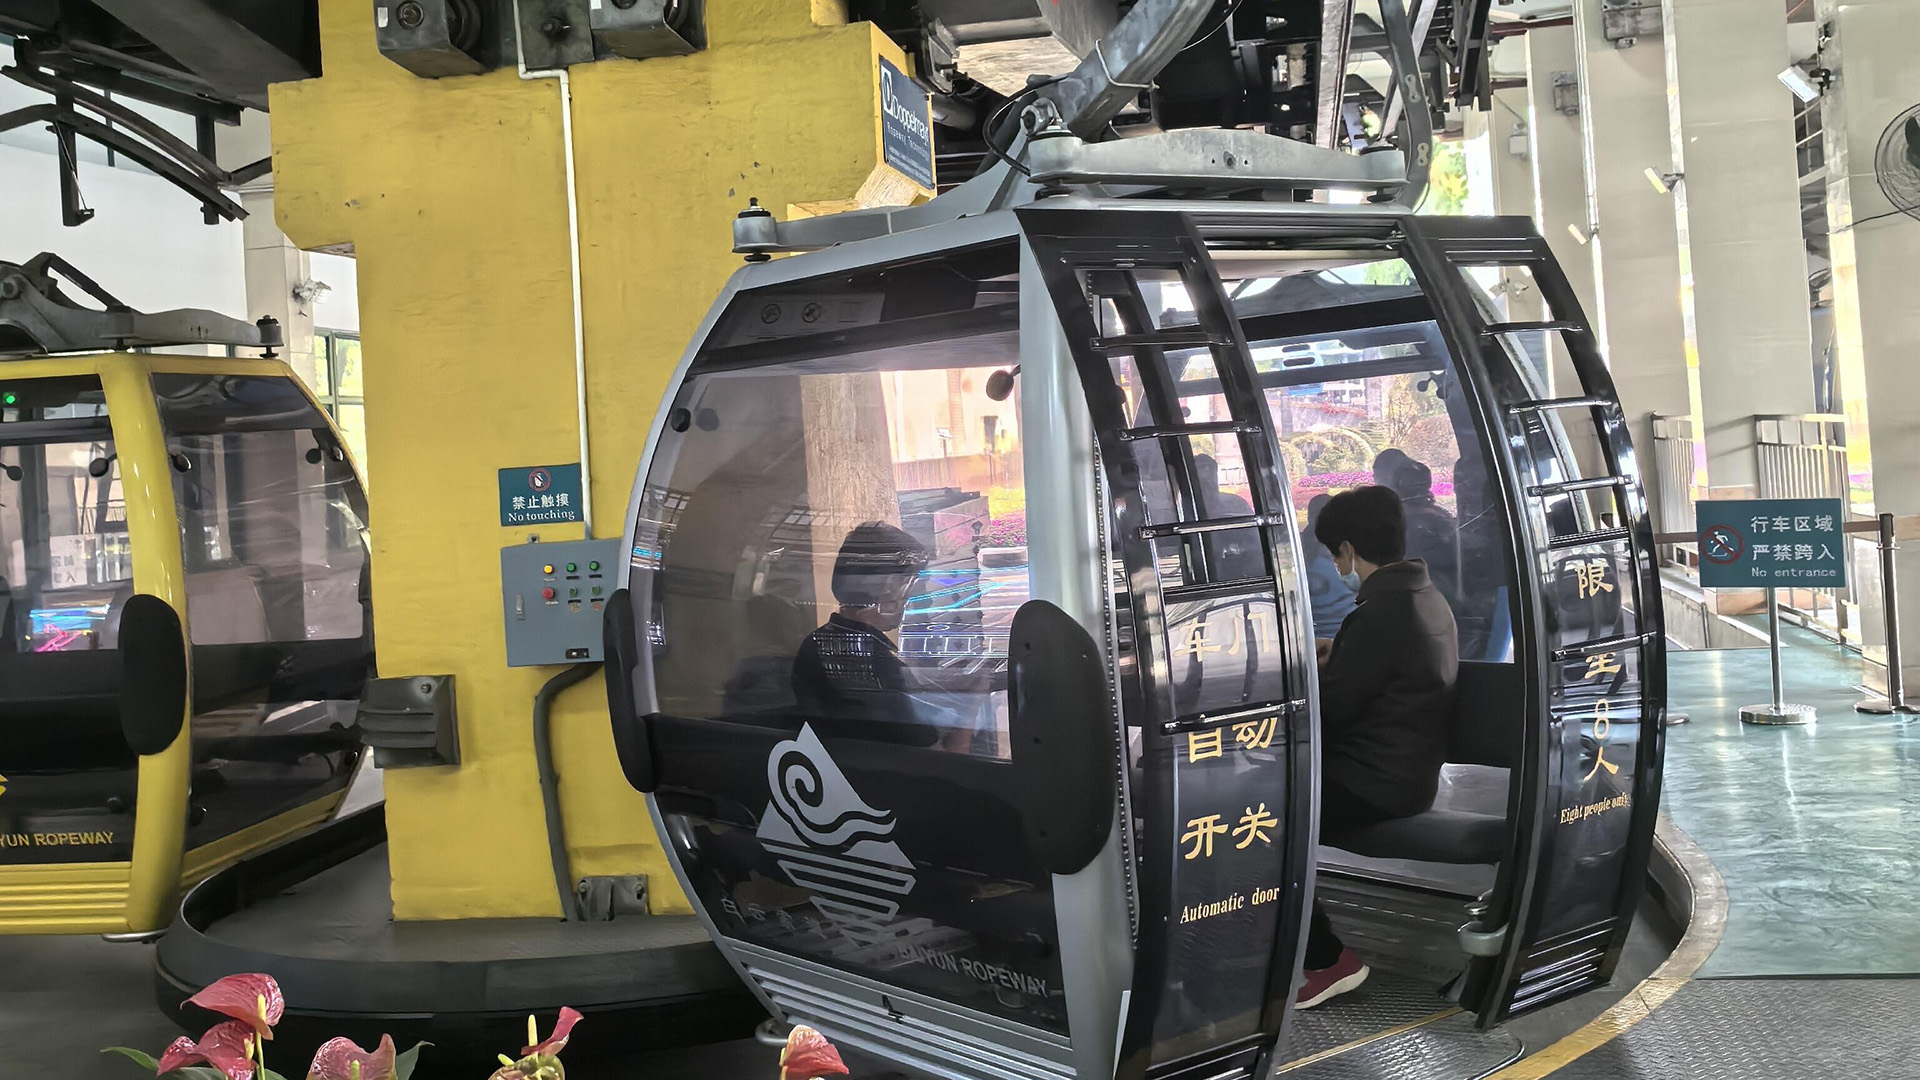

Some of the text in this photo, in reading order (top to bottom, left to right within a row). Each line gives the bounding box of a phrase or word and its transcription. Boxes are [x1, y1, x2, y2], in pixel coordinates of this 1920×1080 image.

[512, 493, 569, 510] 禁止触摸
[508, 509, 575, 522] No touching
[1751, 515, 1834, 533] 行车区域
[1752, 544, 1835, 561] 严禁跨入
[1752, 567, 1836, 577] No entrance
[1174, 612, 1270, 662] 车门
[1187, 717, 1279, 764] 自动
[1560, 804, 1583, 824] Eight
[1583, 797, 1612, 820] people
[33, 832, 114, 846] ROPEWAY
[1180, 802, 1279, 860] 开关
[1180, 887, 1280, 924] Automatic door
[959, 957, 1048, 998] ROPEWAY
